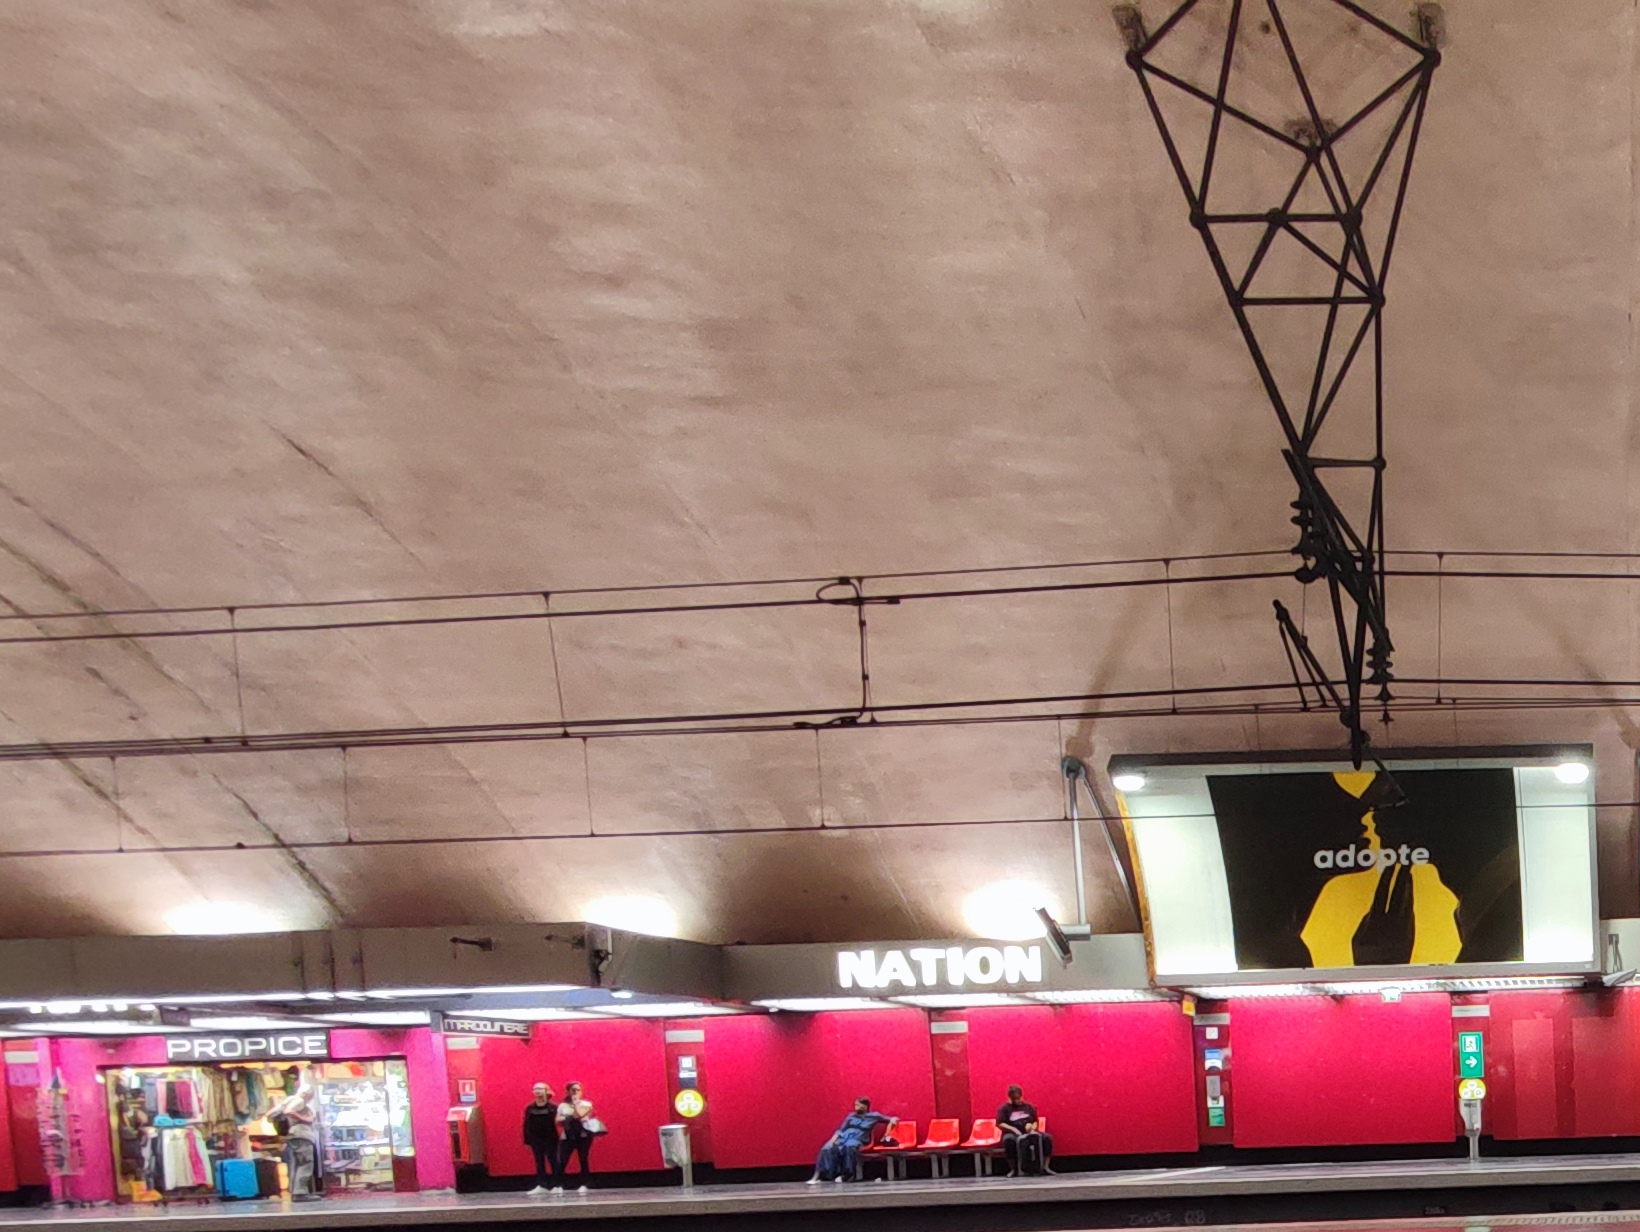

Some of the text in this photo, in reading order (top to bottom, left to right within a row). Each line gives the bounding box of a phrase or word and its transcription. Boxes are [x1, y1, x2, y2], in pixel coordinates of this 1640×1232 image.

[1313, 844, 1430, 873] adopte
[838, 945, 1042, 988] NATION
[166, 1035, 328, 1059] PROPICE
